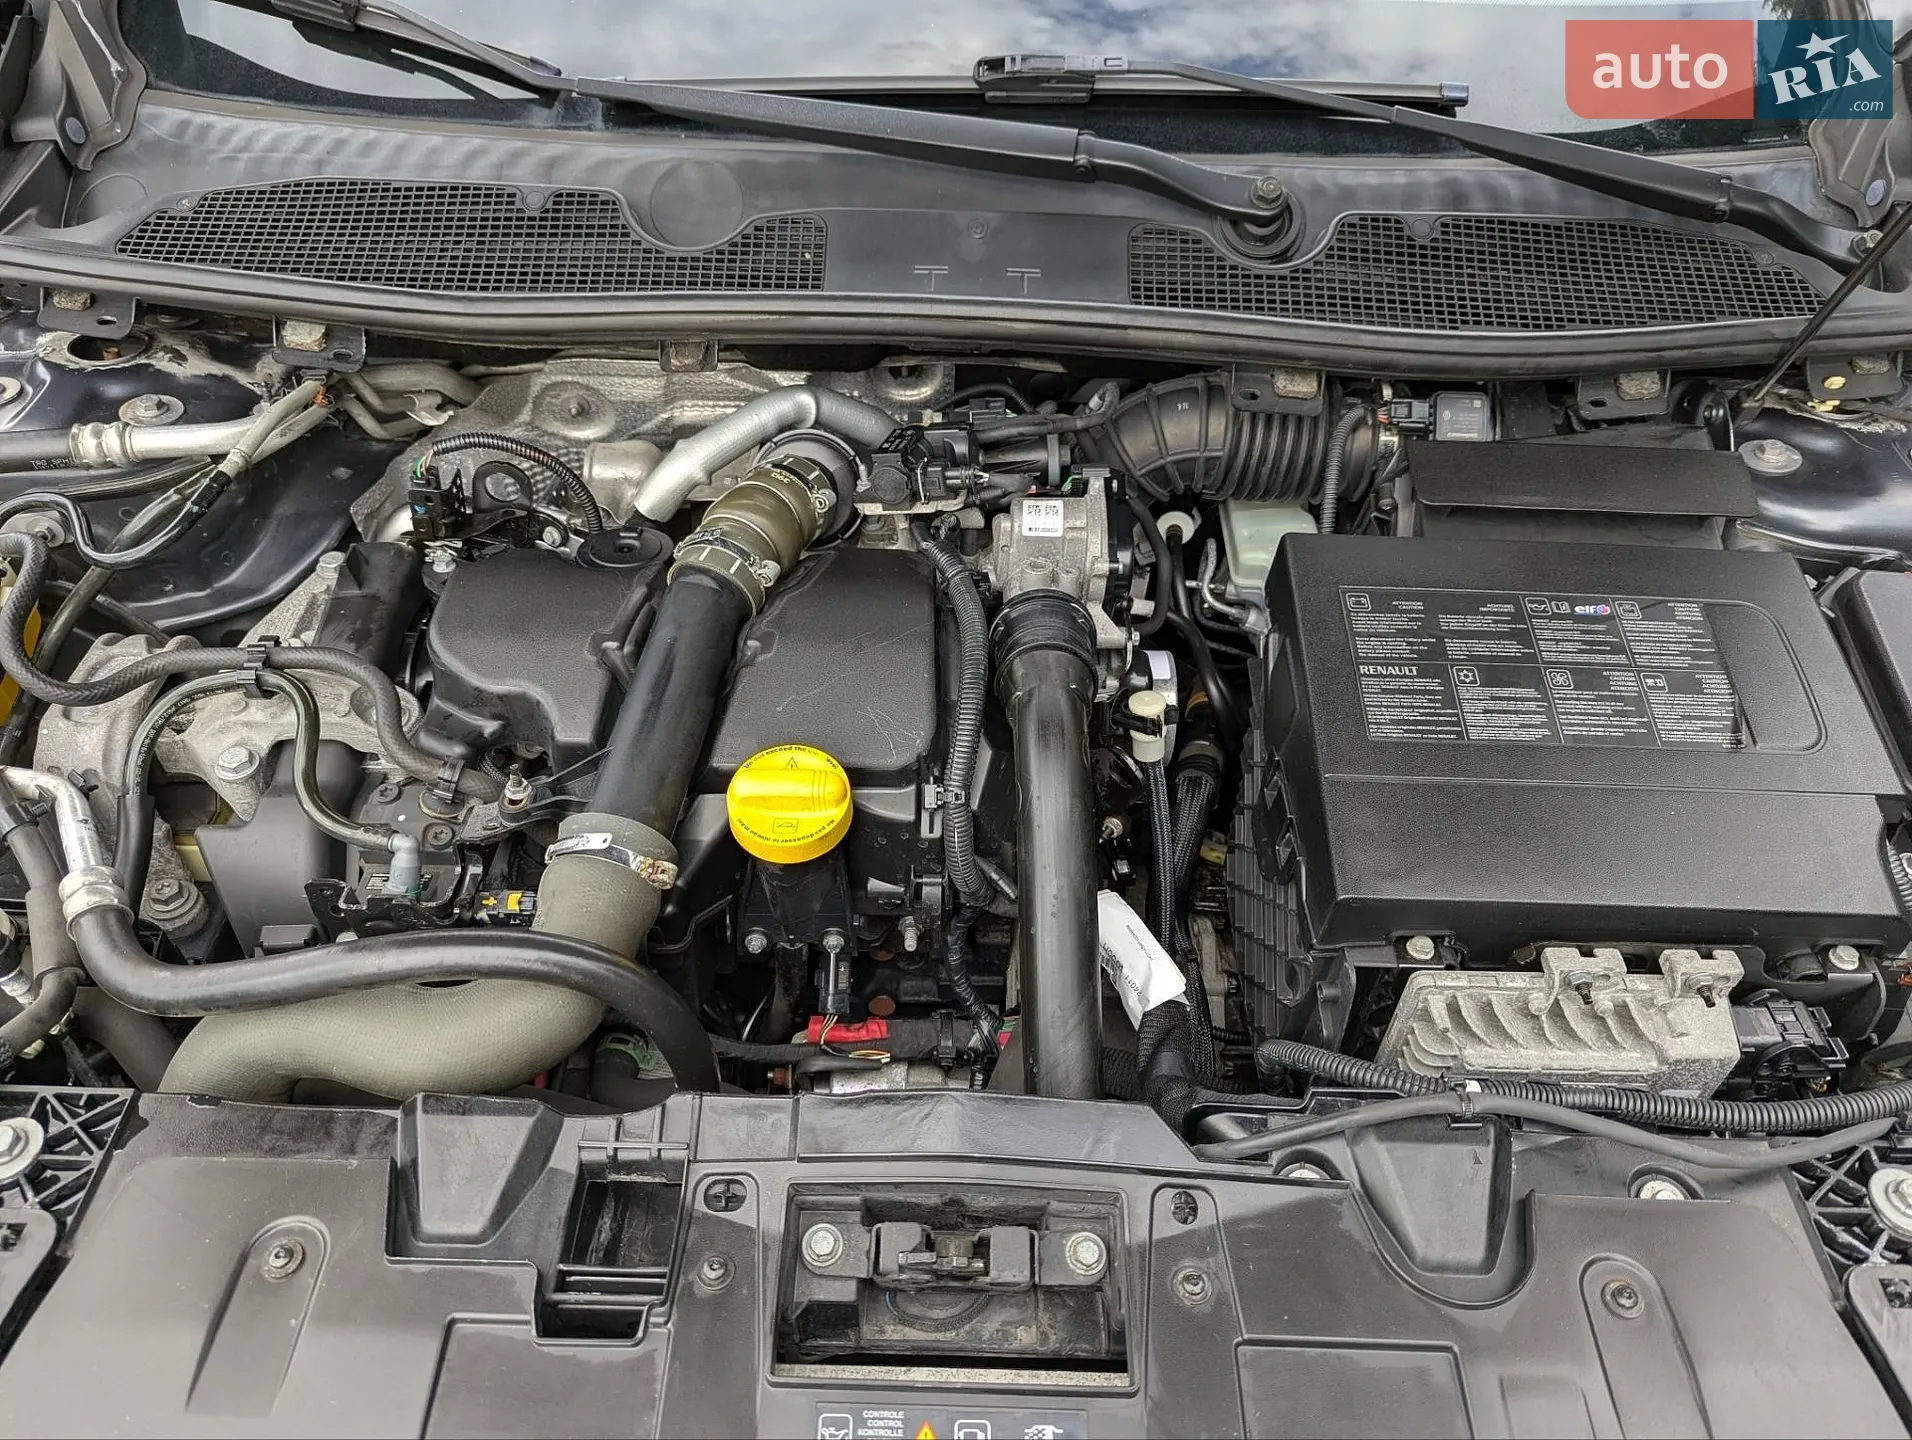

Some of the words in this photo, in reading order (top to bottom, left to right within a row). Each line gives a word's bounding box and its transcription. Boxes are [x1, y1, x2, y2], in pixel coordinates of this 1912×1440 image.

[1574, 604, 1598, 614] elf
[1359, 665, 1419, 675] RENAULT
[766, 746, 793, 756] exceed
[867, 1419, 904, 1427] CONTROL
[857, 1428, 904, 1437] KONTROLLE
